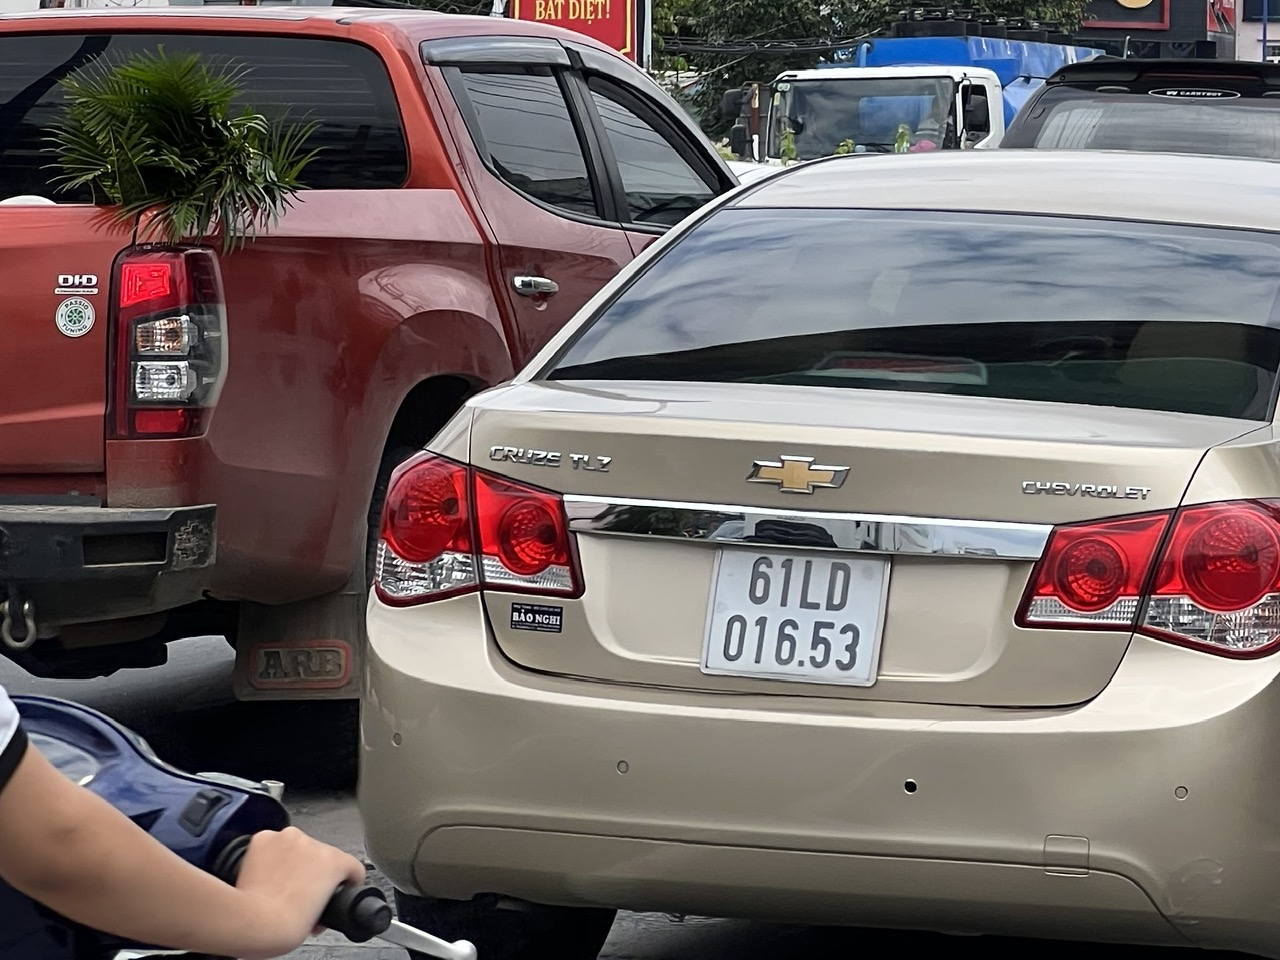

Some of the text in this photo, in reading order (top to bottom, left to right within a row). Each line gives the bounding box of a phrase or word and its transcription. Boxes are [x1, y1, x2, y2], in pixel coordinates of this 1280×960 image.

[64, 300, 89, 310] PASSIO
[62, 323, 88, 334] TUNING
[490, 446, 561, 467] CRUZE
[1022, 481, 1151, 500] CHEVROLET
[749, 556, 852, 612] 61LD
[535, 614, 561, 625] NGHI
[723, 614, 861, 671] 016.53
[260, 647, 346, 682] ARB
